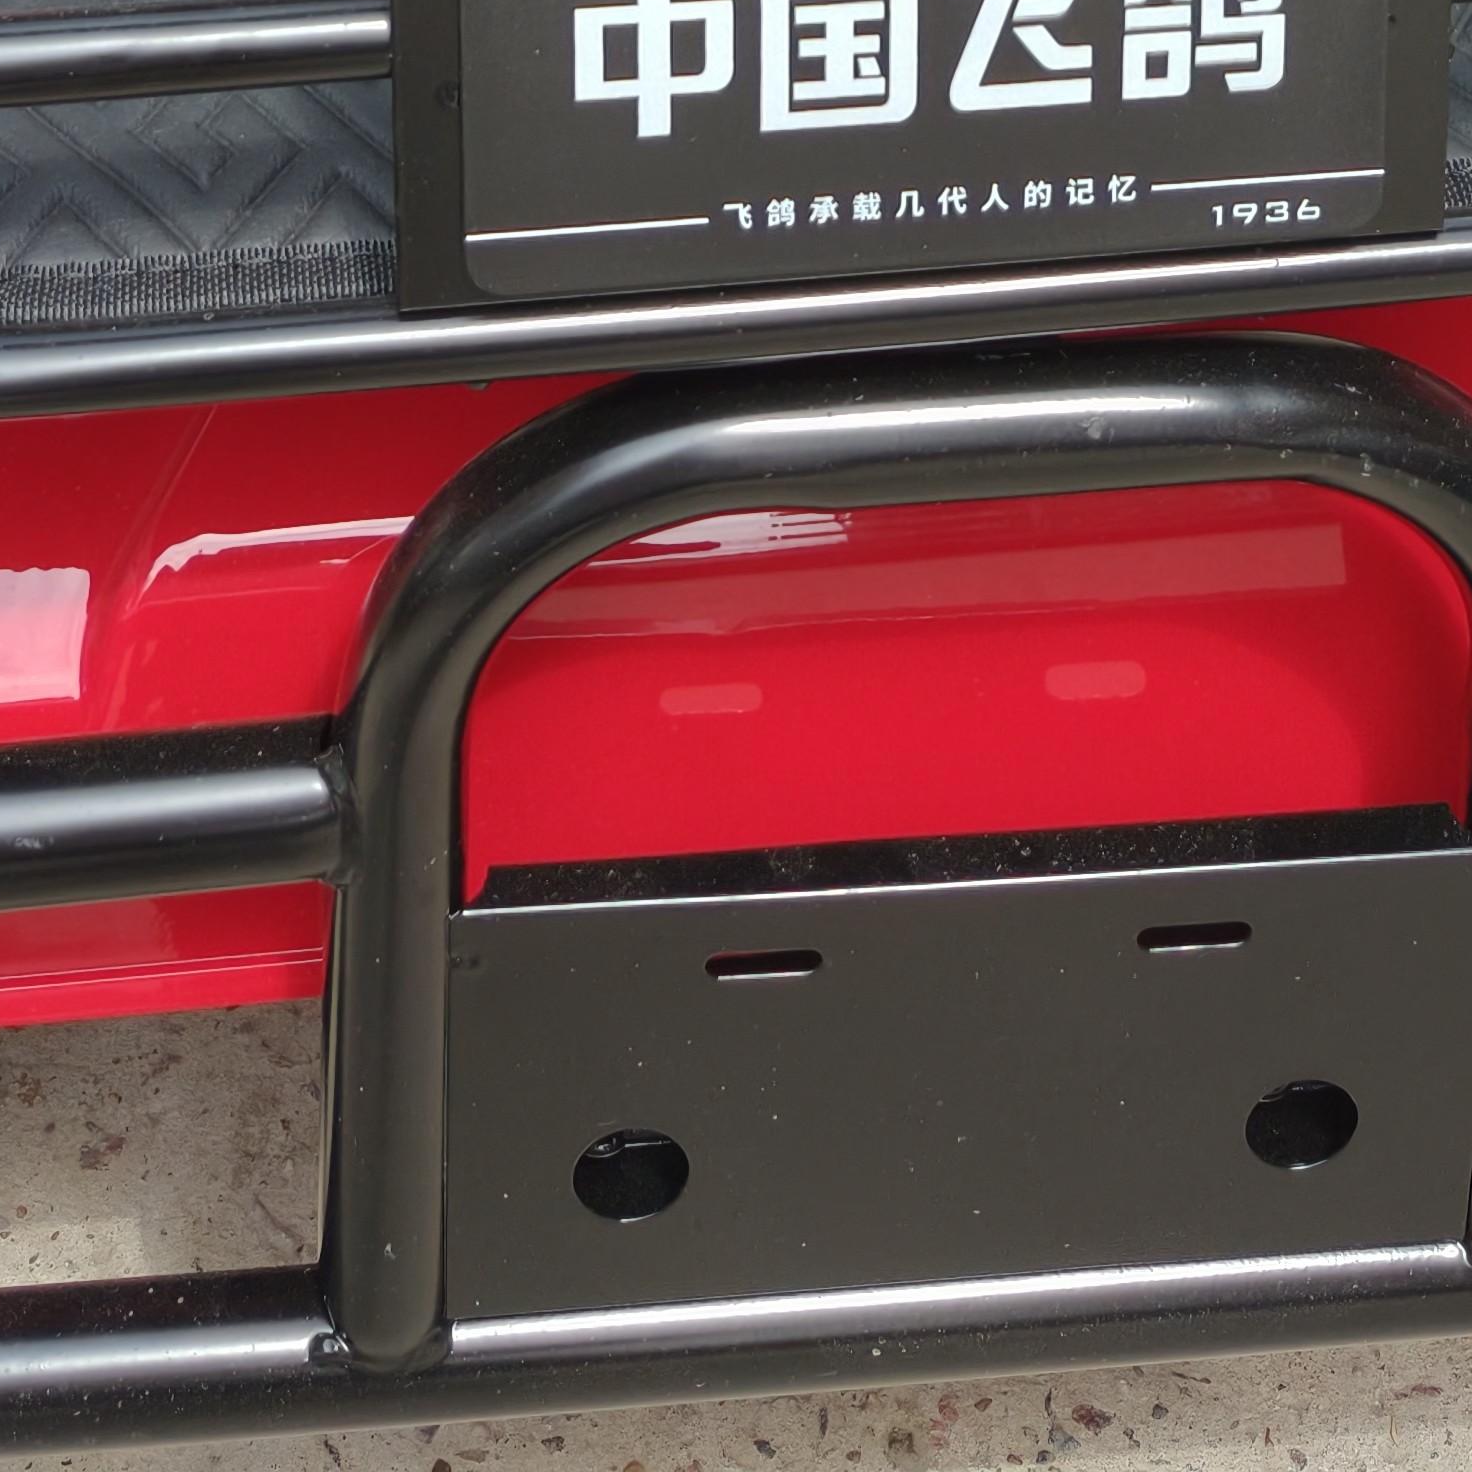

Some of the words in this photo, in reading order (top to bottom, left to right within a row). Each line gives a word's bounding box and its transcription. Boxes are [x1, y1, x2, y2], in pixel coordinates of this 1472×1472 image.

[723, 173, 1140, 231] 飞鸽承载几代人的记忆
[1210, 198, 1322, 227] 1936
